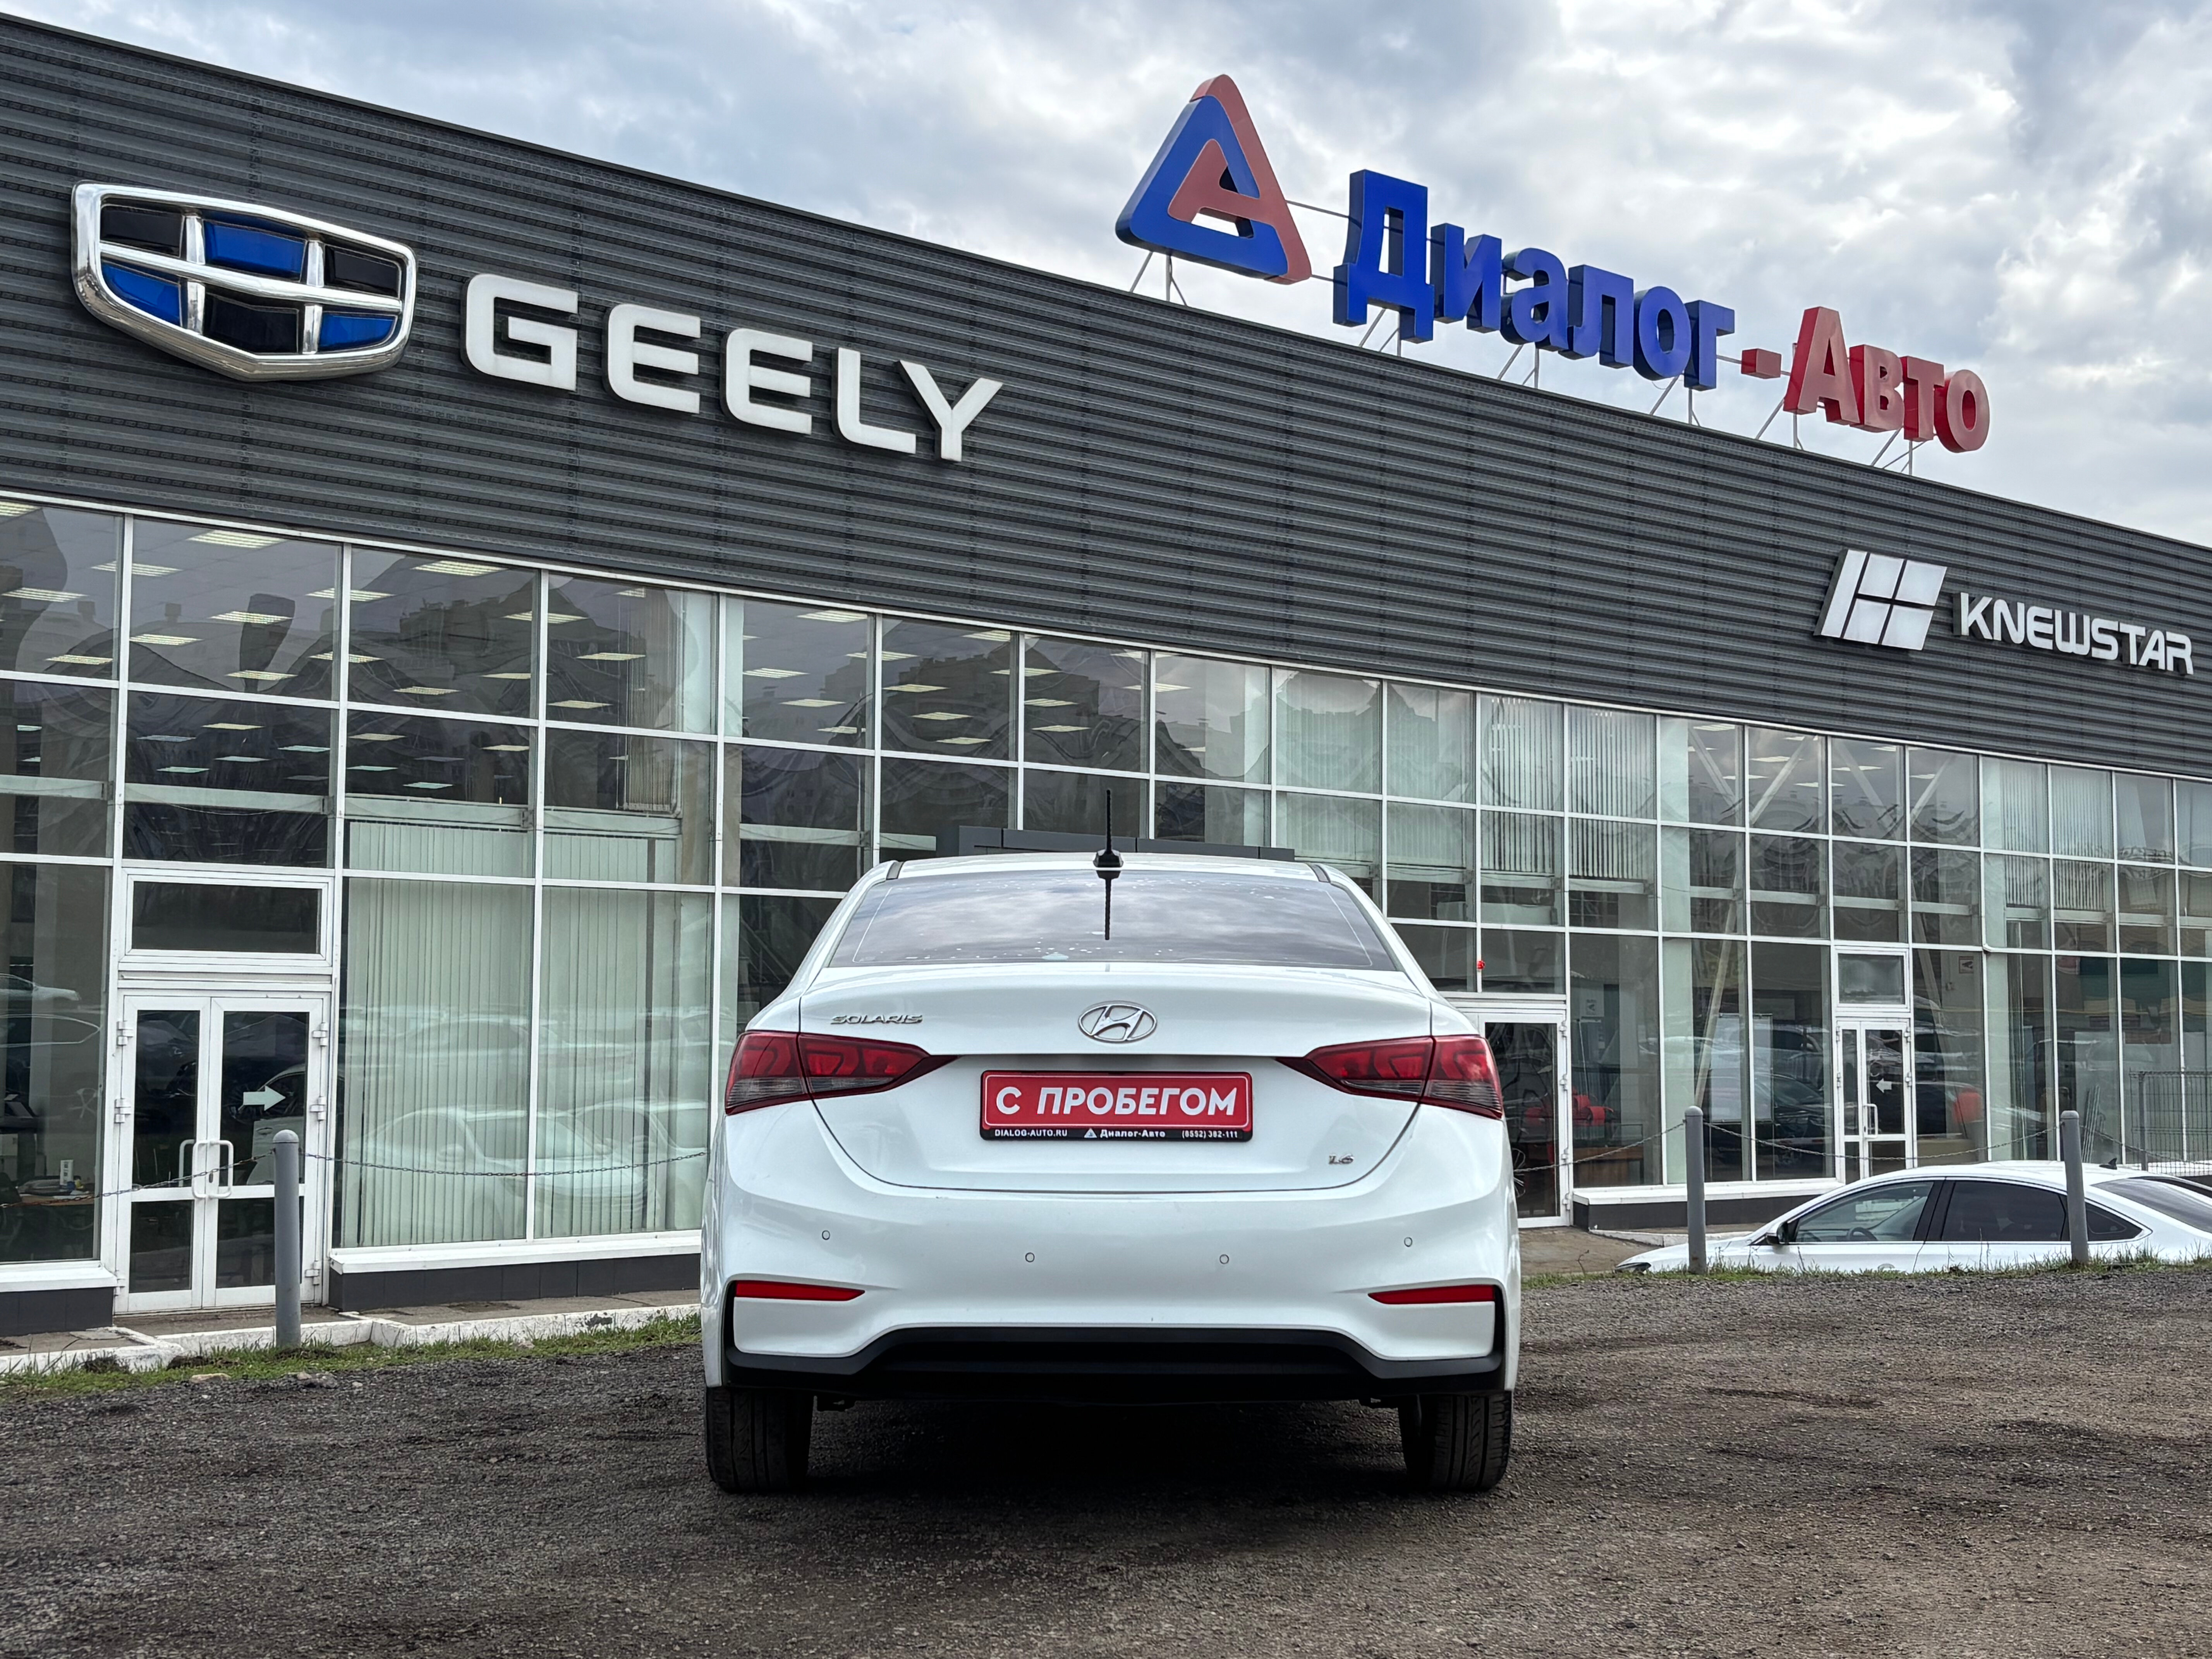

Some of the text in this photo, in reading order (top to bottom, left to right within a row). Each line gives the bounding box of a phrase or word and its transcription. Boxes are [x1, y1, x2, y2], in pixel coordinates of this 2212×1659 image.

[1334, 169, 1990, 452] Диалог-Авто
[462, 272, 1003, 462] GEELY
[1956, 591, 2195, 675] KNEWSTAR
[830, 1014, 923, 1025] SOLARIS
[996, 1086, 1237, 1116] С ПРОБЕГОМ
[994, 1129, 1068, 1137] DIALOG-AUTO.RU
[1099, 1129, 1166, 1138] Диалог-Авто
